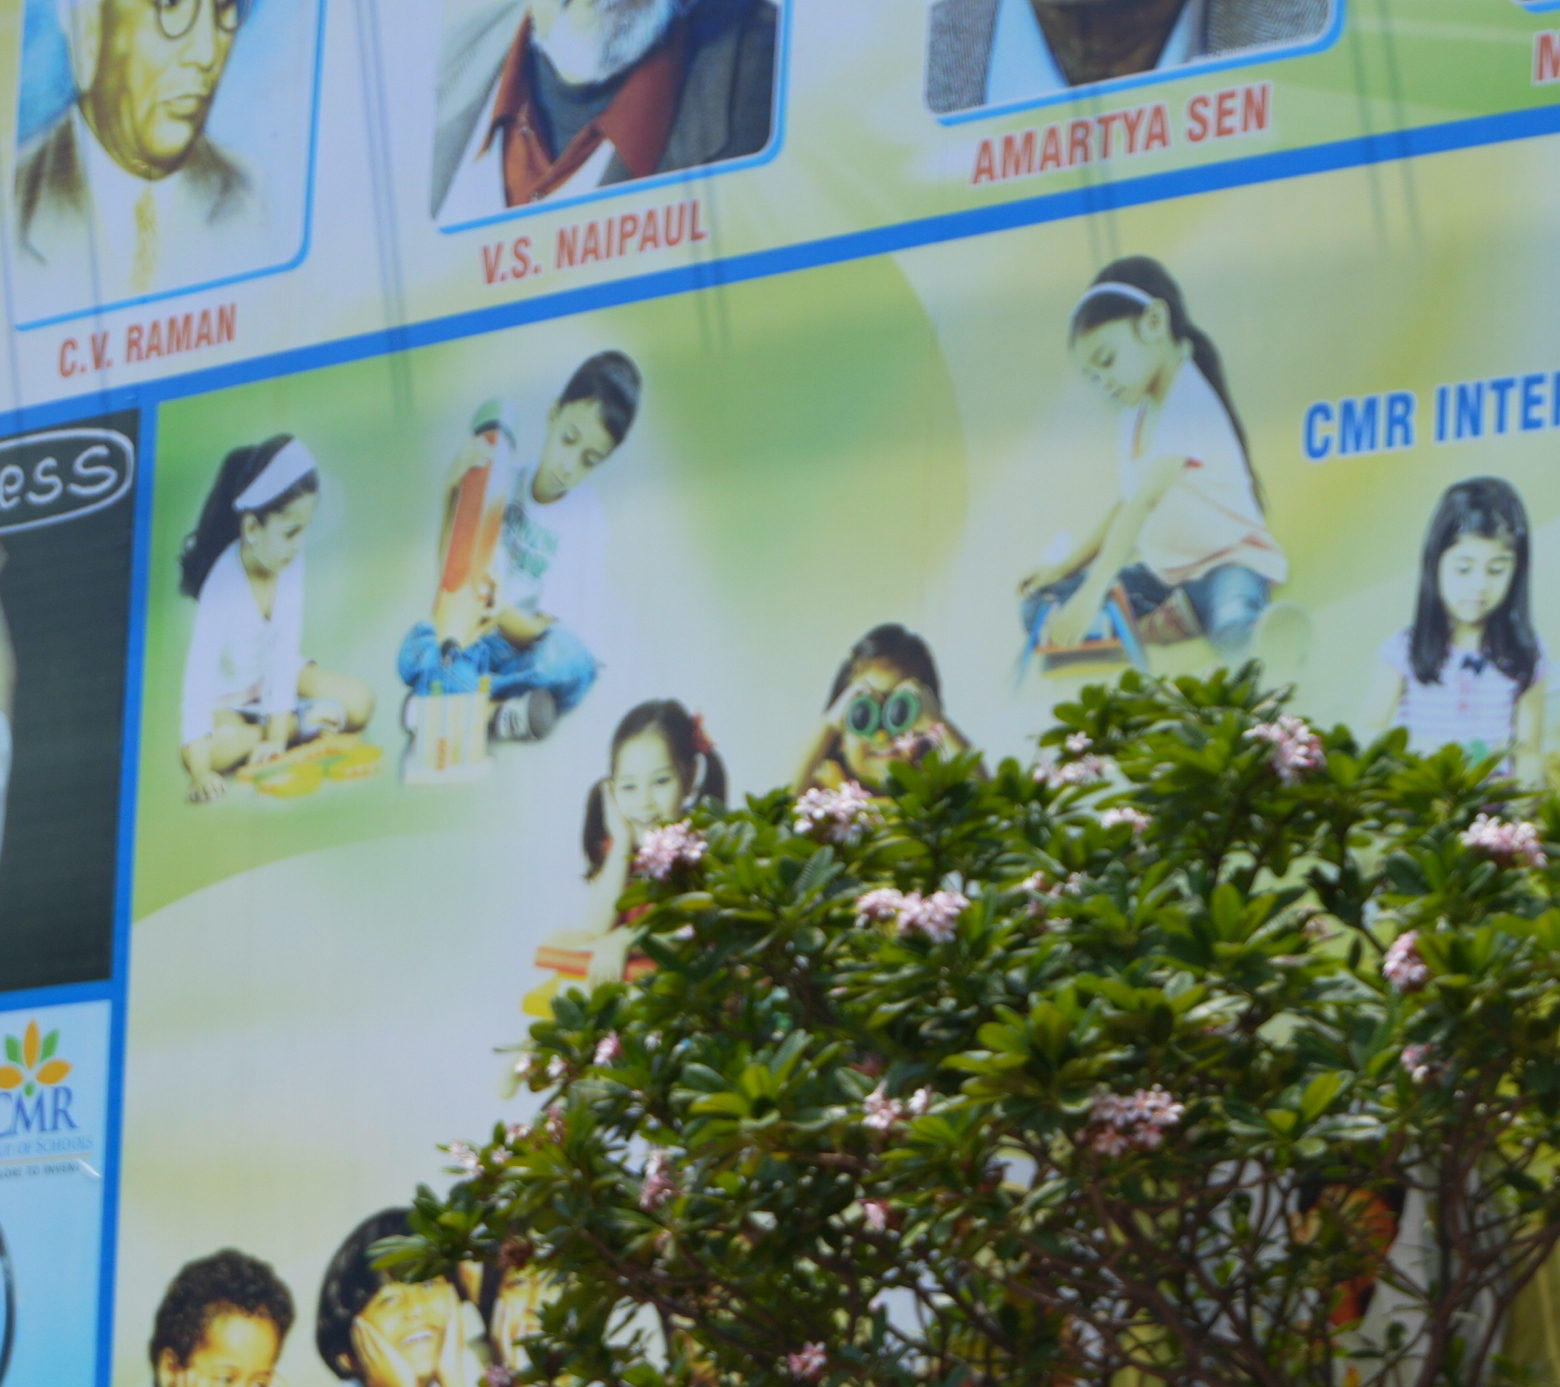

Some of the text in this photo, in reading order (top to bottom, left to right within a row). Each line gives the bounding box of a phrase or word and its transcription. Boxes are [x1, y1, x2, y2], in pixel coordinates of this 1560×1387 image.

[971, 83, 1270, 185] AMARTYA SEN
[482, 199, 709, 285] V.S. NAIPAUL
[59, 302, 237, 378] C.V. RAMAN
[1304, 391, 1416, 460] CMR
